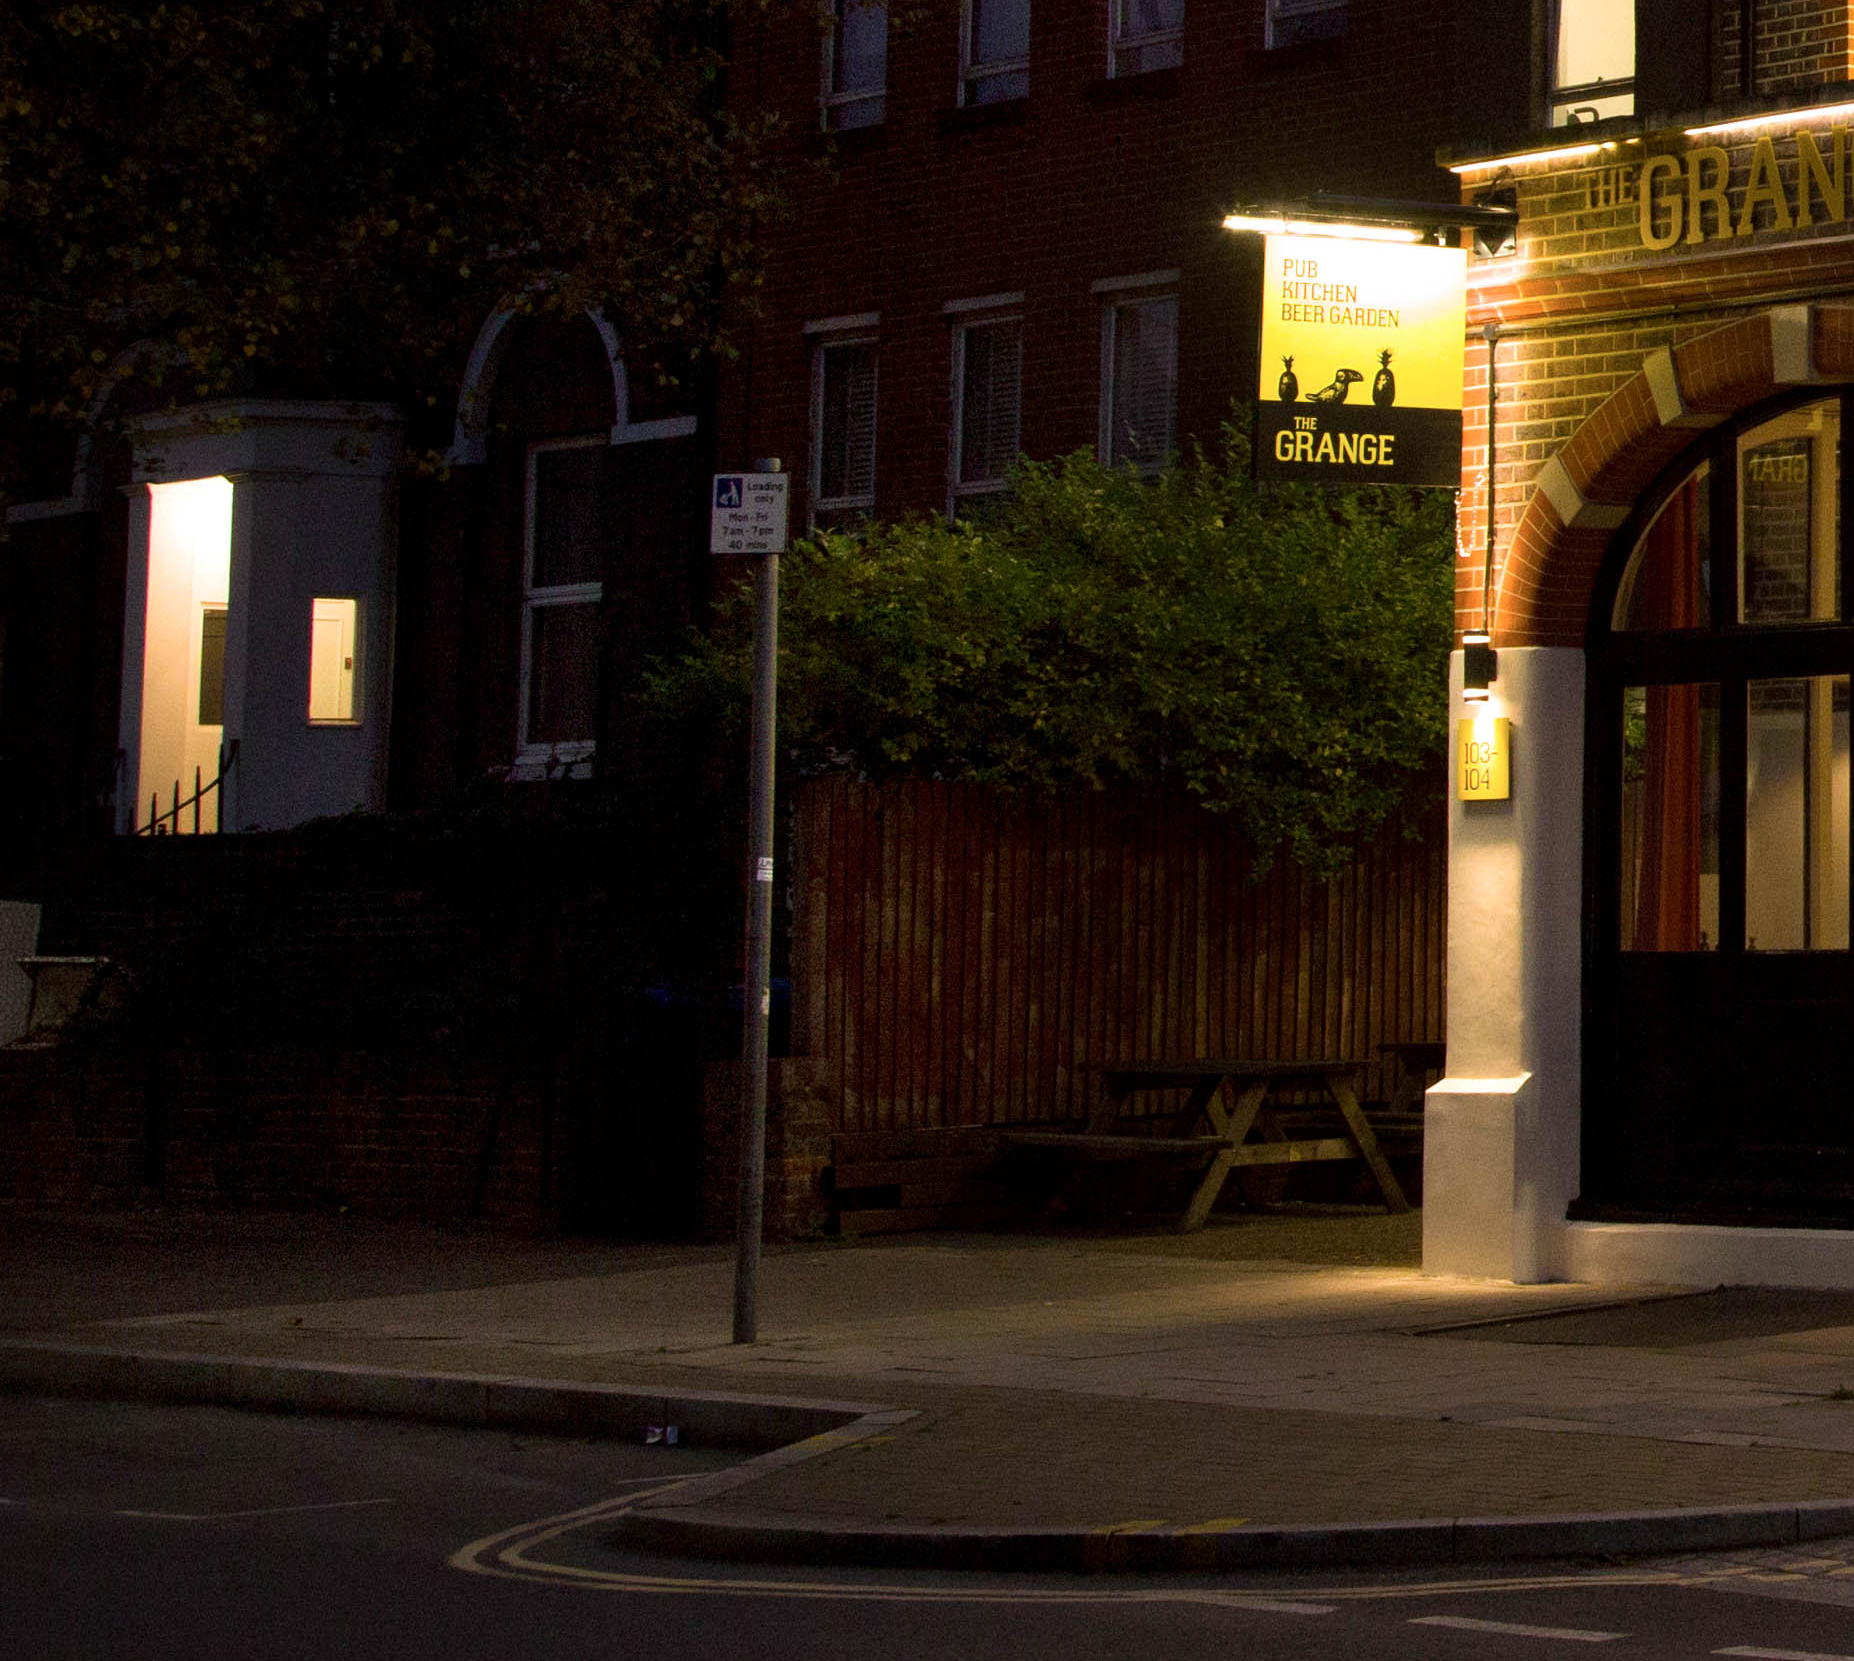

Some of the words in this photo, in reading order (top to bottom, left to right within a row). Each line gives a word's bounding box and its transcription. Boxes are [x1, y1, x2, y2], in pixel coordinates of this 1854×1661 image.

[1580, 167, 1634, 210] THE
[1281, 258, 1318, 278] PUB
[1282, 281, 1357, 303] KITCHEN
[1281, 303, 1325, 323] BEER
[1329, 305, 1400, 328] GARDEN
[1294, 416, 1317, 430] THE
[1275, 430, 1395, 466] GRANGE
[747, 482, 784, 492] Loading
[754, 493, 774, 504] only
[1464, 768, 1489, 791] 104
